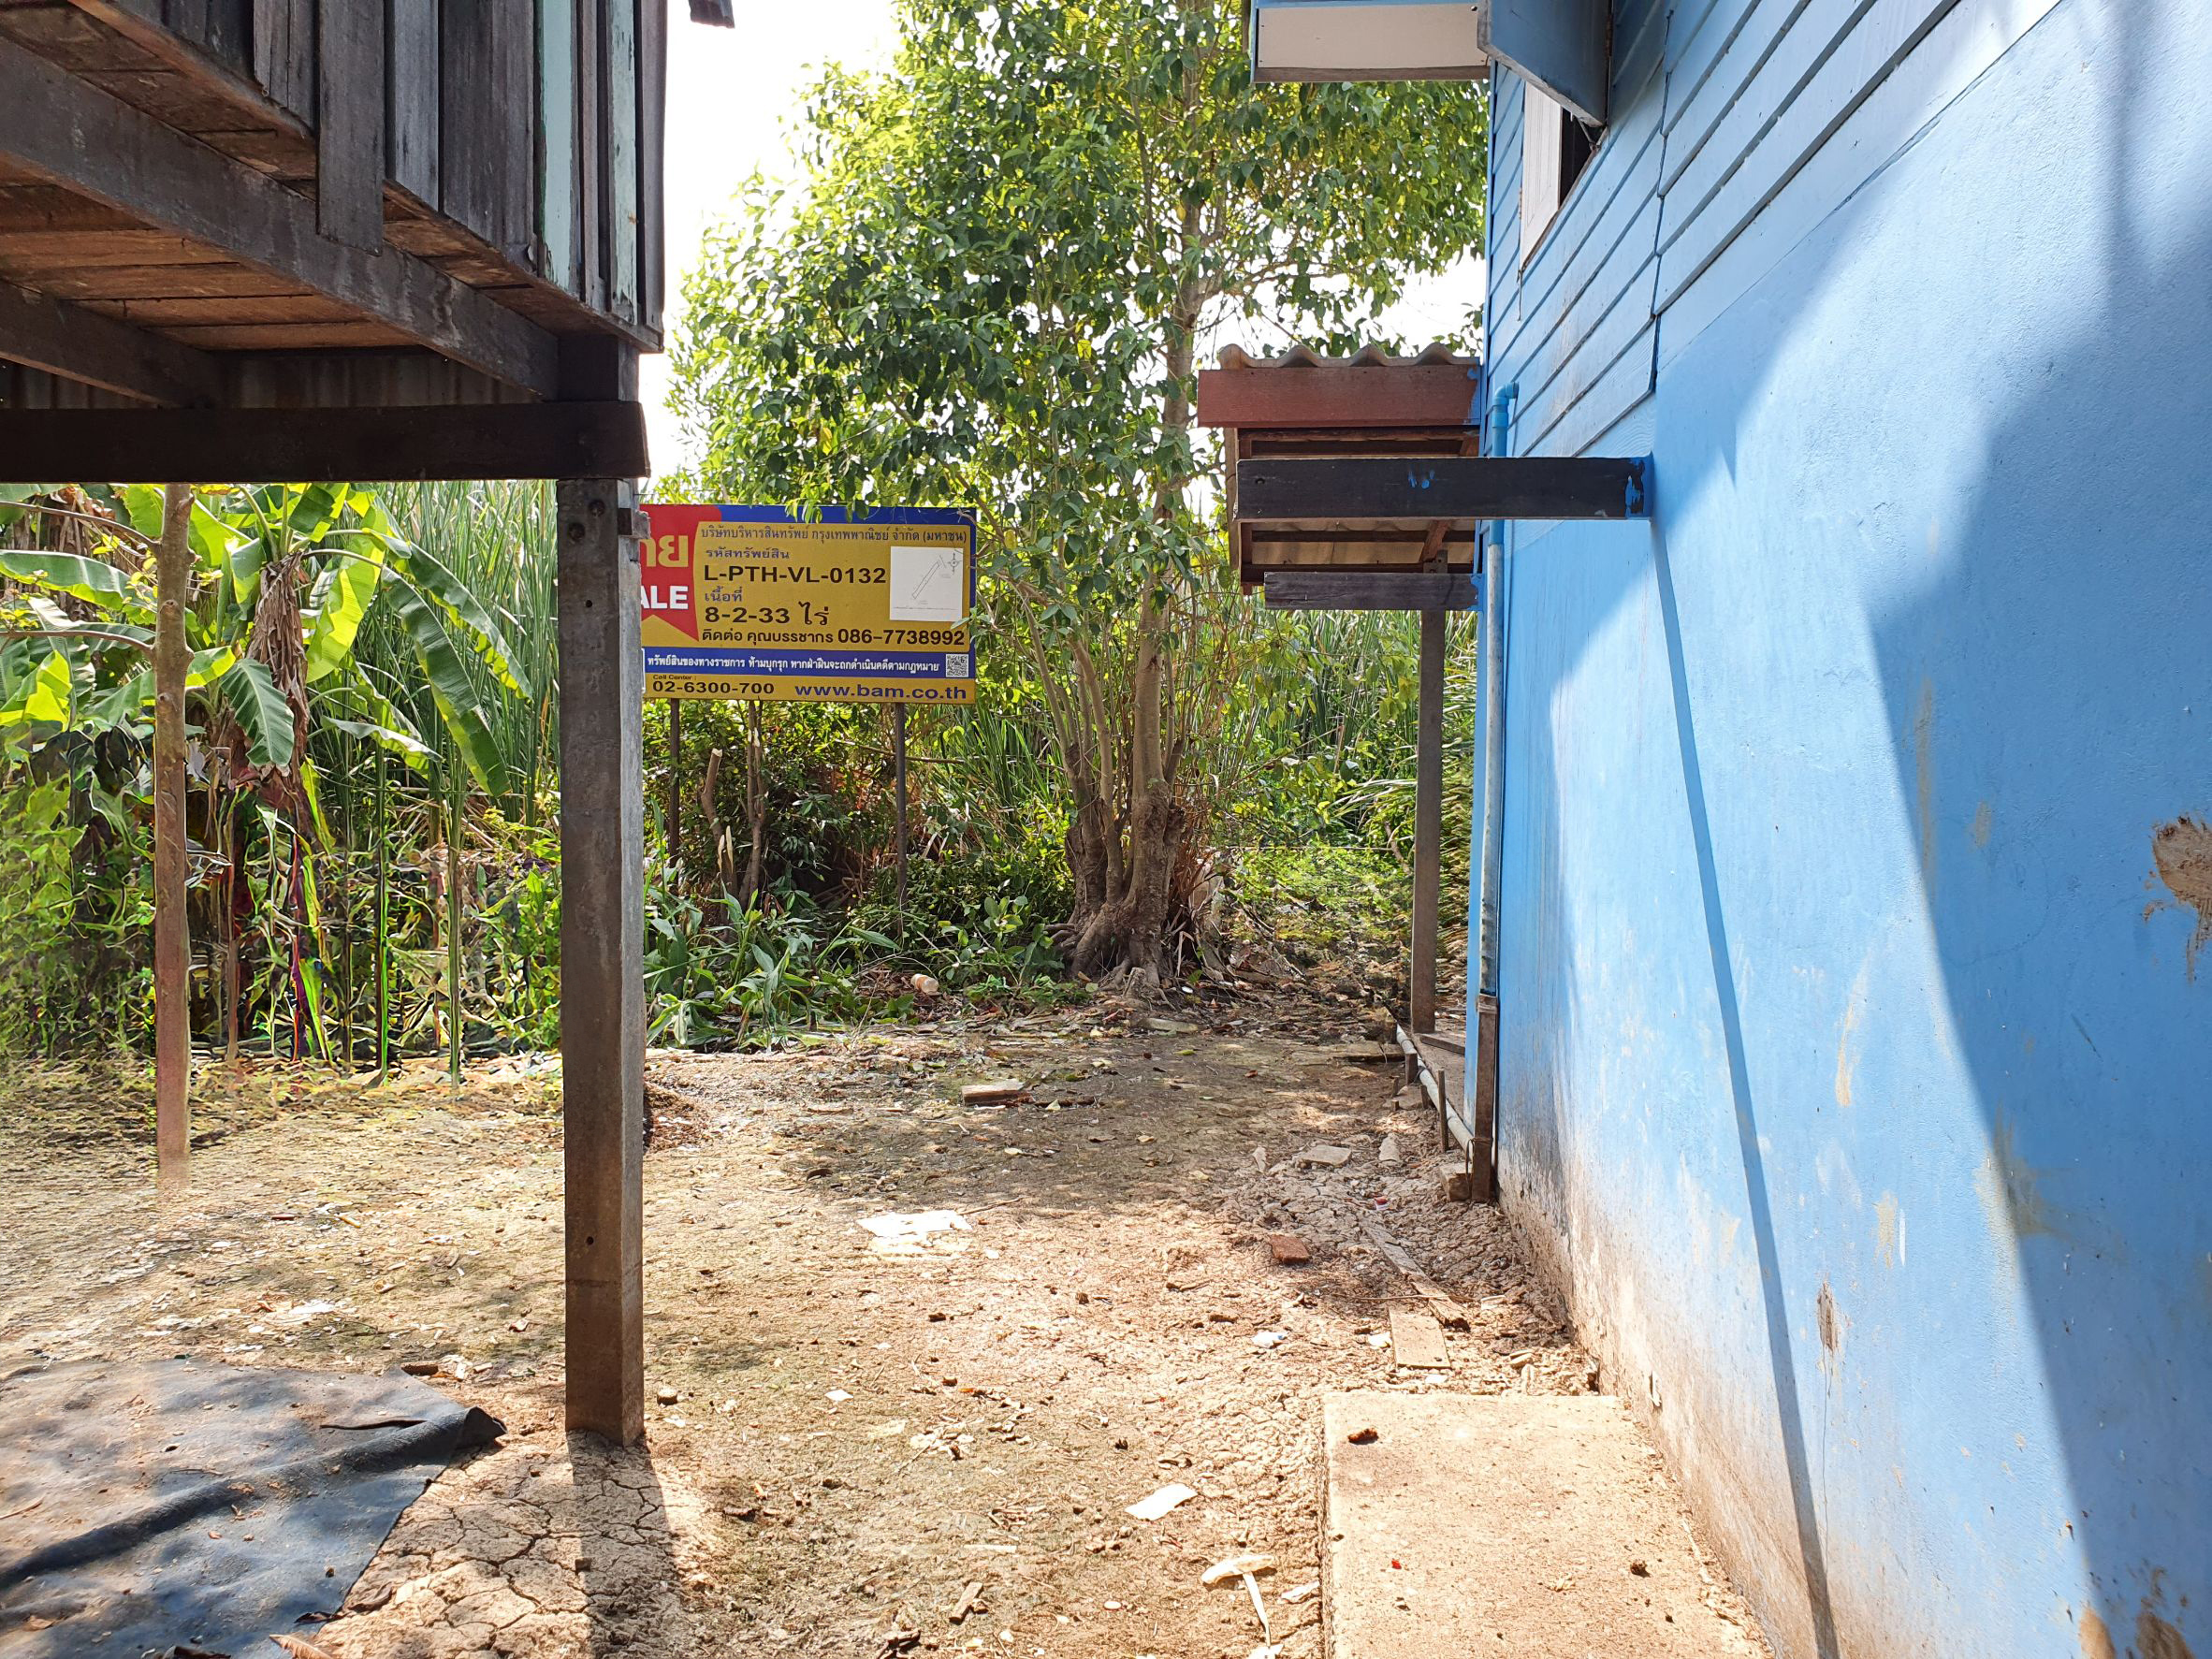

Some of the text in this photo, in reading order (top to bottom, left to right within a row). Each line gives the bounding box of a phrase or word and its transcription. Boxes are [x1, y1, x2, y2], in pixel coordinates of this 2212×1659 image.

[893, 528, 920, 541] จำกัด
[923, 531, 968, 543] (มหาชน)
[639, 534, 689, 568] าย
[706, 546, 790, 559] รหัสทรัพย์สิน
[704, 564, 887, 584] L-PTH-VL-0132
[705, 585, 743, 602] เนื้อที่
[705, 601, 830, 626] 8-2-33 ไร่
[702, 628, 743, 641] ติดต่อ
[837, 628, 965, 646] 086-7738992
[652, 680, 967, 700] 02-6300-700 www.bam.co.th
